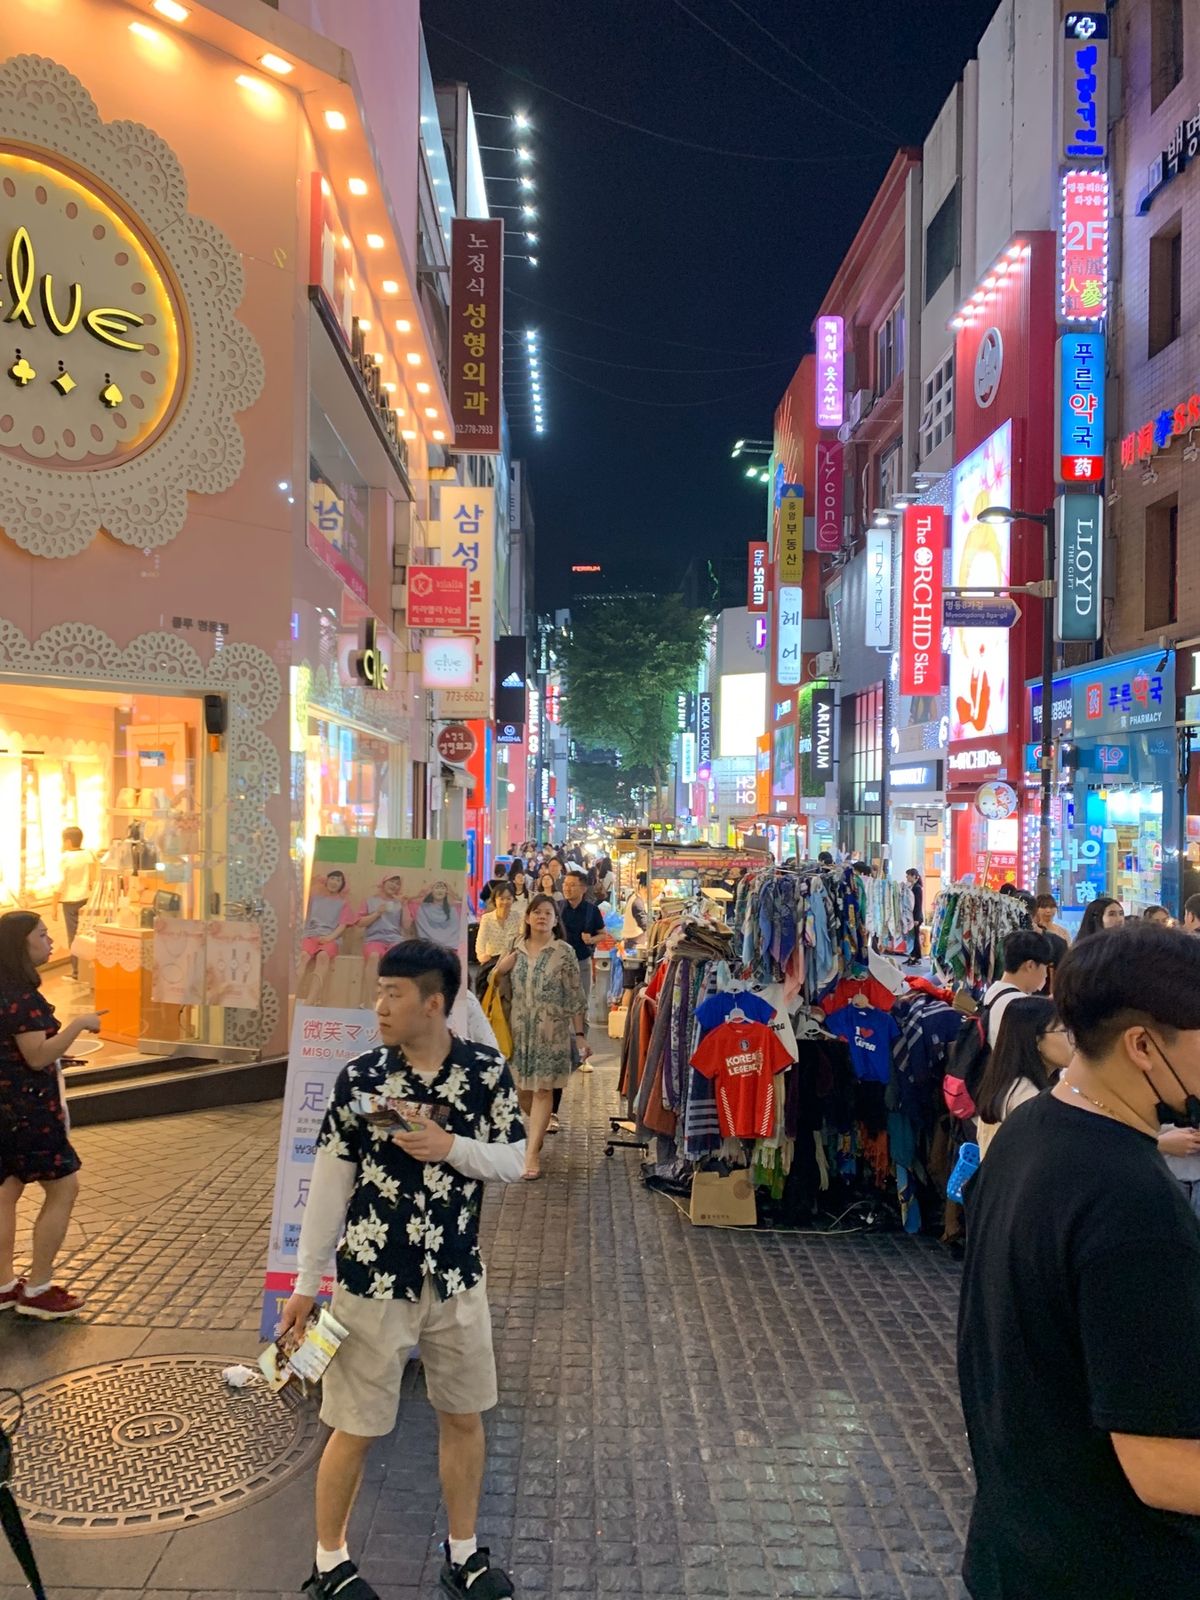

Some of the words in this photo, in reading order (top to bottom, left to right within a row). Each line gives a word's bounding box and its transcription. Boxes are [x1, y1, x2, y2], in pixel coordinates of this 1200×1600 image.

[1067, 221, 1104, 250] 2F
[467, 233, 489, 297] 노정식
[1065, 277, 1080, 293] 人
[463, 303, 488, 416] 성형외과
[1070, 343, 1097, 448] 푸른약국
[452, 504, 484, 573] 삼성
[786, 524, 797, 566] 부동산
[916, 516, 931, 544] The
[1075, 519, 1093, 615] LLOYD
[753, 567, 765, 605] SAEM
[875, 541, 884, 633] TONYMOLY
[912, 546, 933, 651] ORCHID
[781, 610, 799, 660] 헤어
[914, 652, 931, 685] Skin
[446, 691, 484, 701] 773-6622
[528, 691, 539, 733] BANILA
[1108, 675, 1163, 712] 푸른약국
[701, 697, 711, 730] HOLIKA
[1129, 711, 1162, 725] PHARMACY
[528, 735, 539, 754] CO
[701, 732, 710, 764] HOLIKA
[817, 702, 831, 769] ARITAUM
[736, 791, 757, 804] HO
[302, 1047, 332, 1058] MISO
[725, 1053, 757, 1067] KOREA
